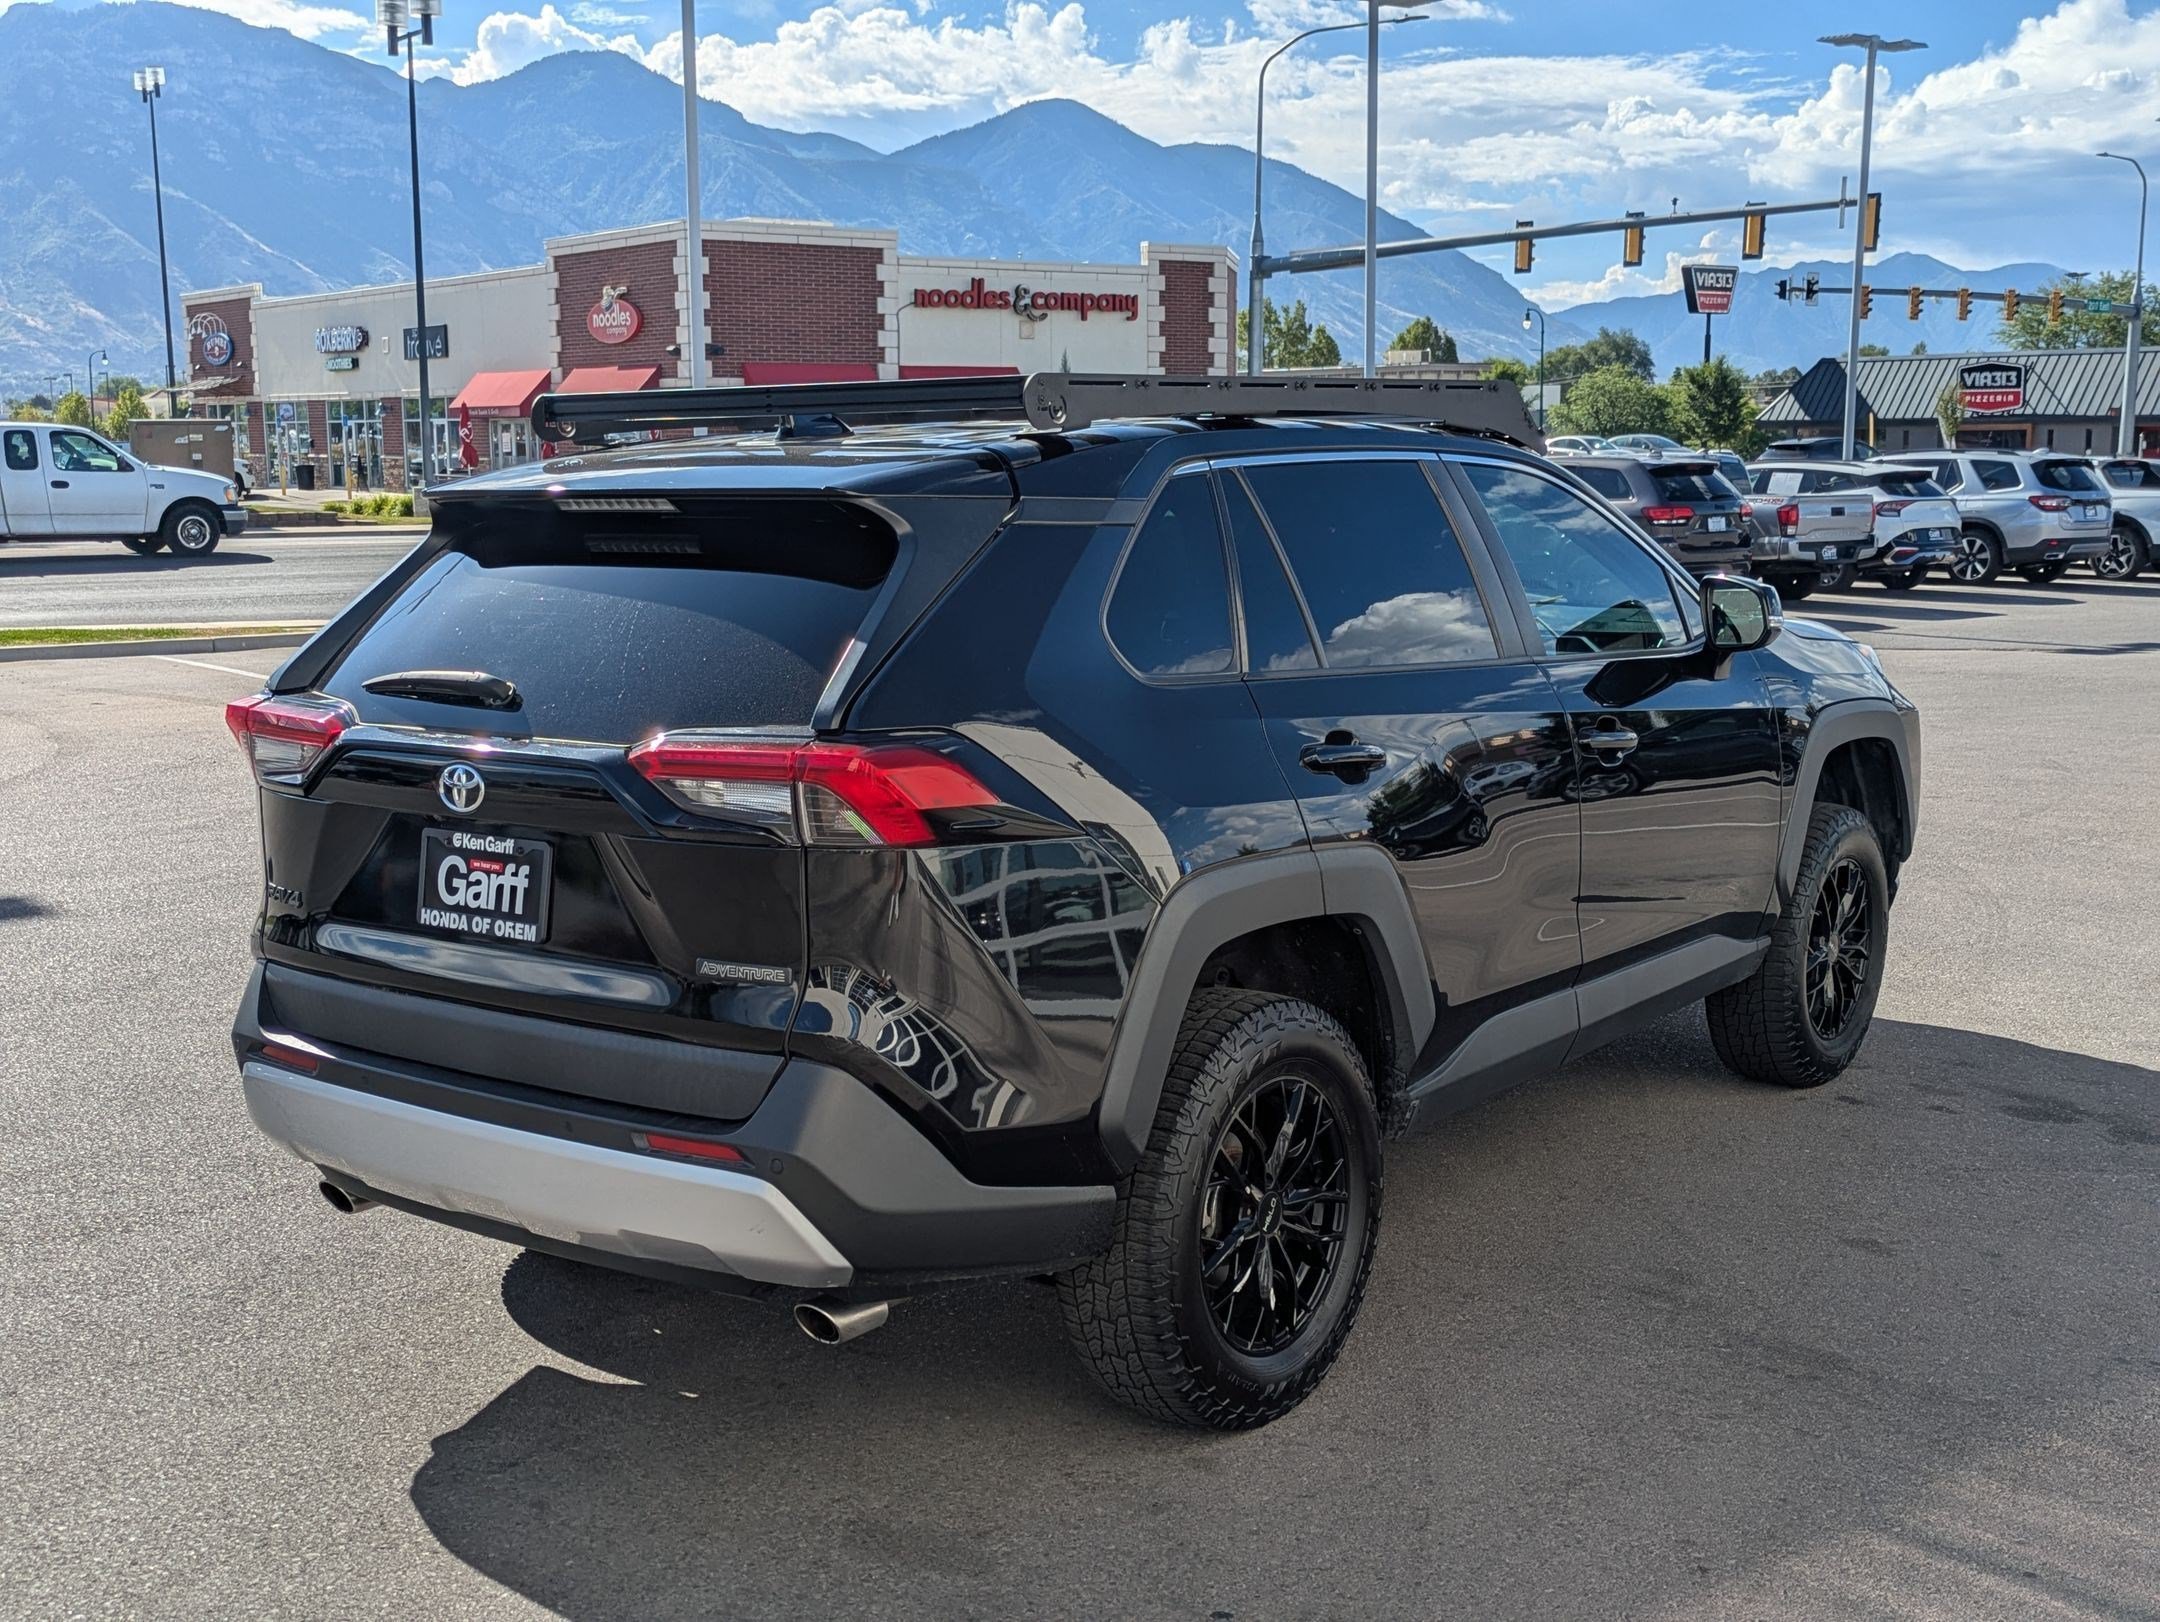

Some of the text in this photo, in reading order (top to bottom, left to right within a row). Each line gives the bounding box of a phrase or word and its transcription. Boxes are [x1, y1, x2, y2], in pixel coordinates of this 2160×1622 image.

[914, 277, 1010, 309] noodles
[1031, 291, 1139, 321] company
[592, 303, 631, 328] noodles
[314, 327, 357, 352] ROXBERRY
[607, 327, 627, 336] company
[1965, 394, 2014, 403] PIZZERIA
[485, 836, 515, 854] Garff
[437, 855, 530, 915] Garff
[420, 908, 537, 942] HONDA OF OREM
[700, 961, 786, 982] ADVENTURE
